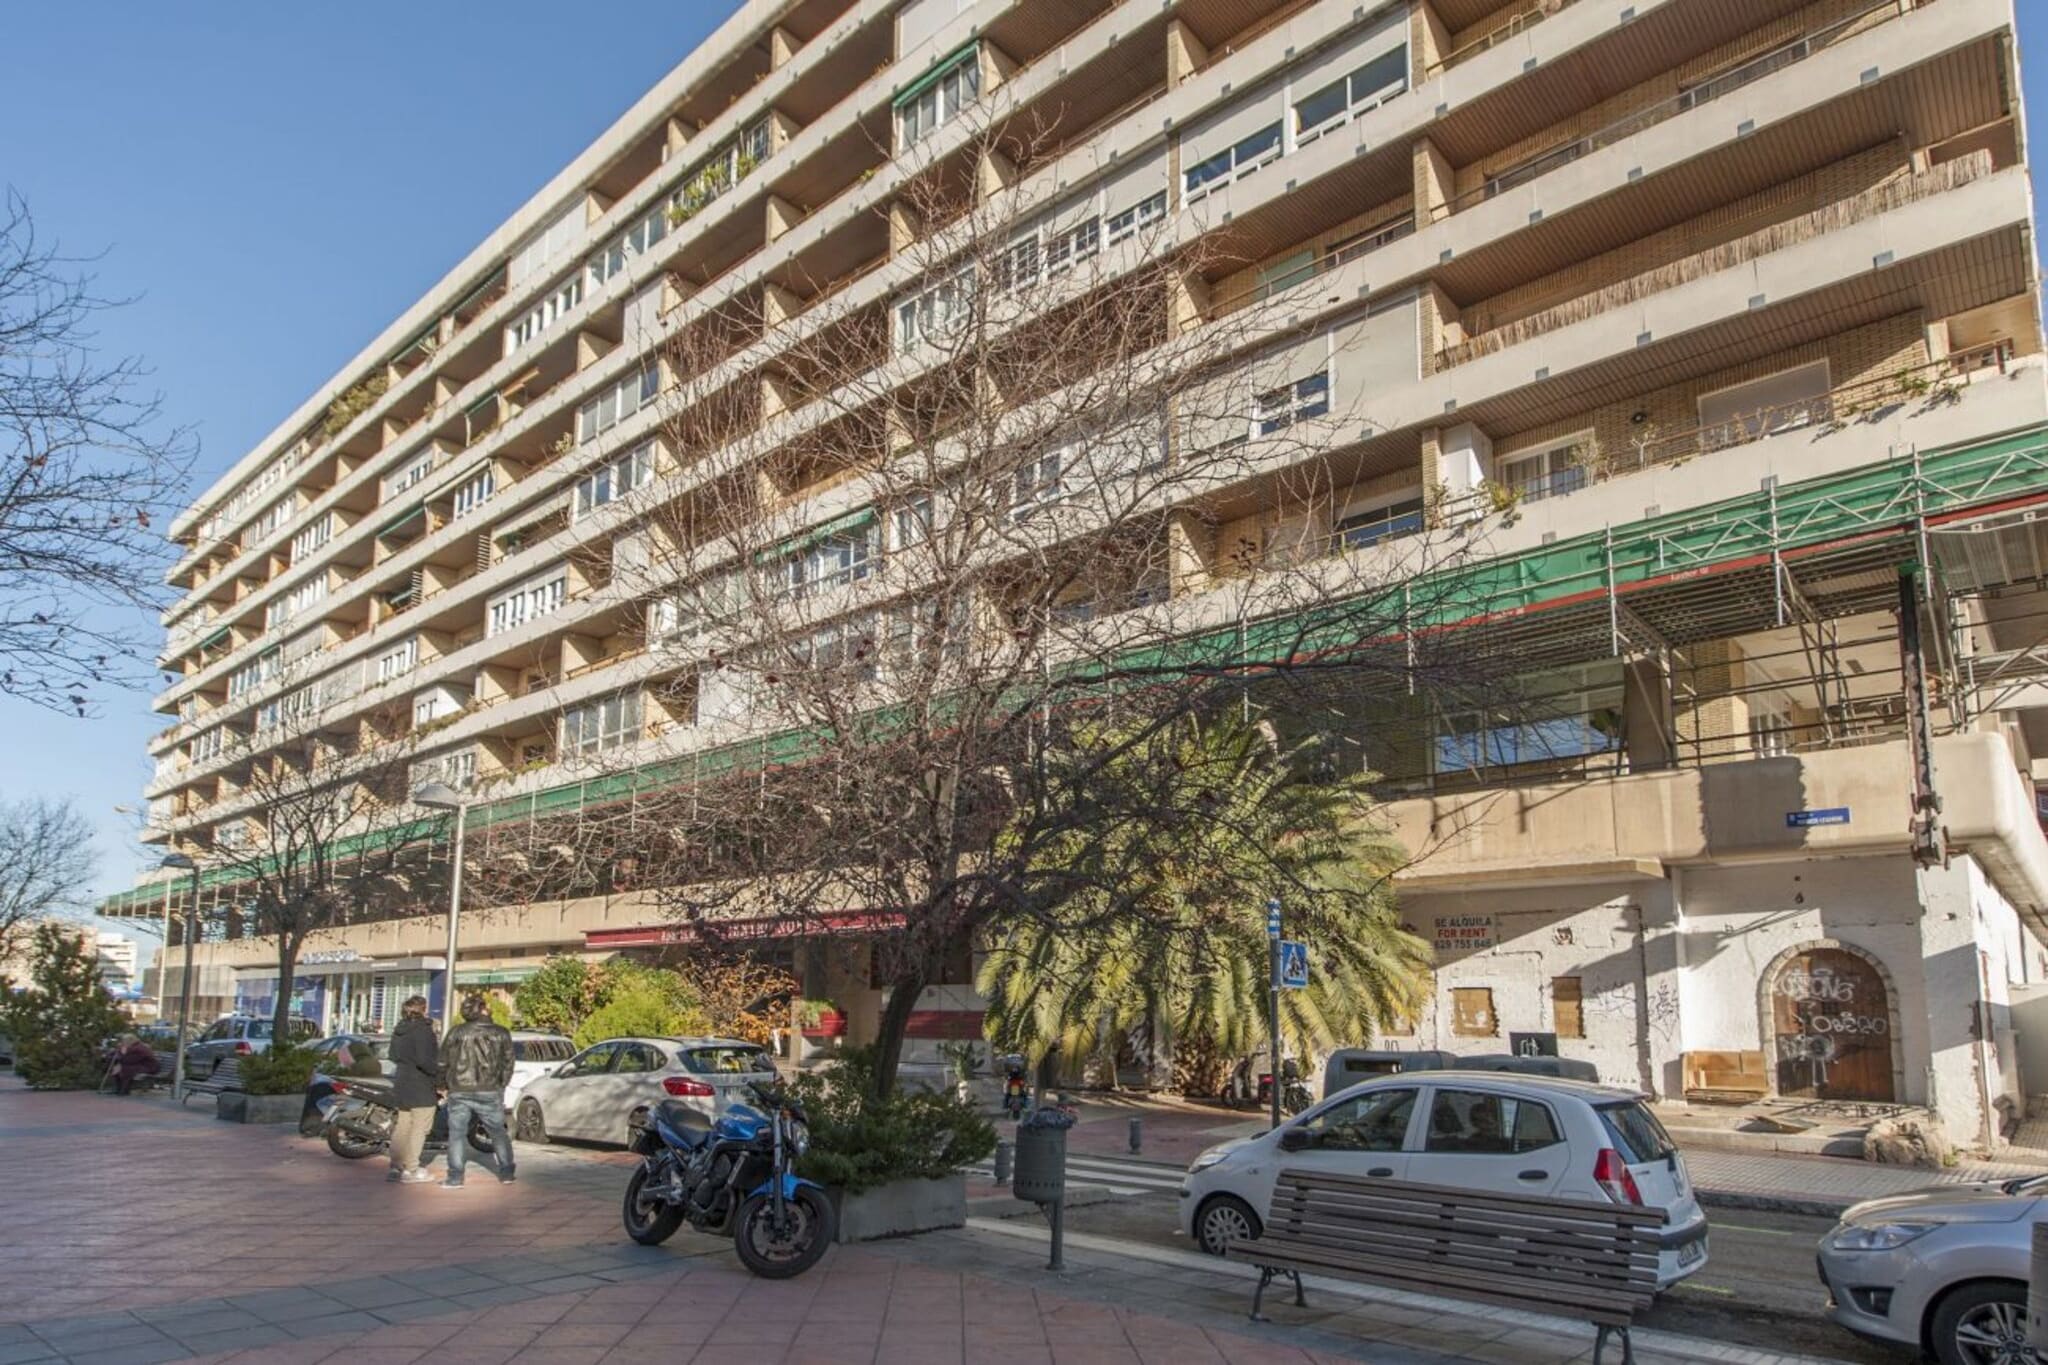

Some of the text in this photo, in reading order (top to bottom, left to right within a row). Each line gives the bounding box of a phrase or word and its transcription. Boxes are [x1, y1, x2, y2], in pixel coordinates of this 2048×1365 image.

[1434, 916, 1492, 928] SE ALQUILA
[1438, 927, 1486, 938] FOR RENT
